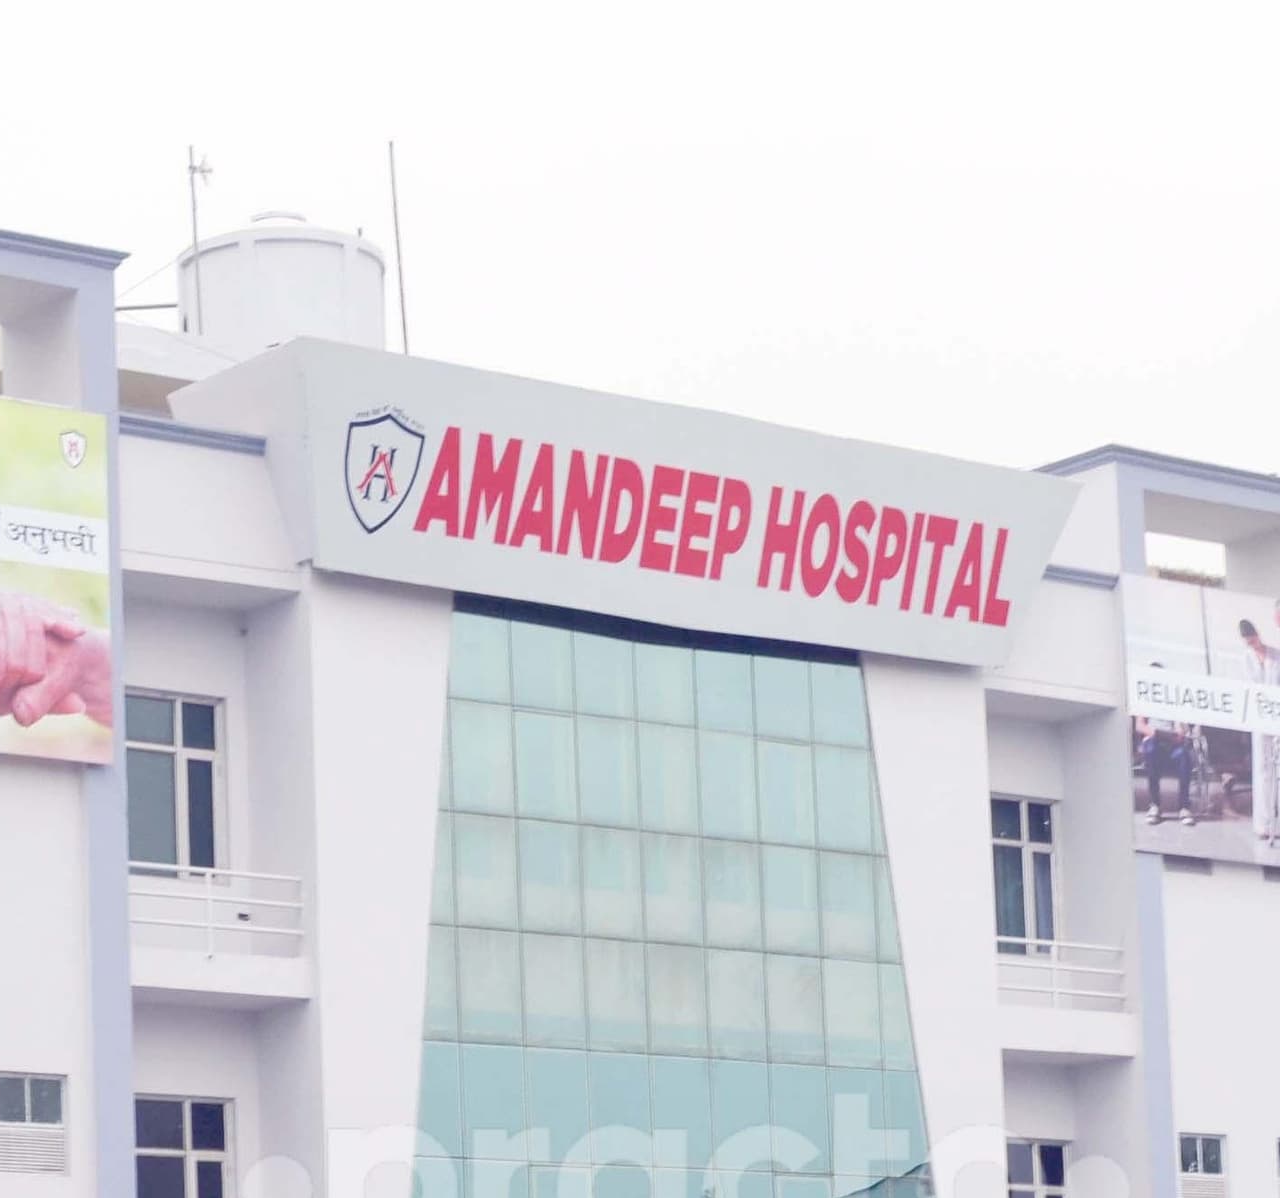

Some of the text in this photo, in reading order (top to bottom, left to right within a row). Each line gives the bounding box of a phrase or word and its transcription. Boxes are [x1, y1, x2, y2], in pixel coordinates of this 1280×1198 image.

[413, 426, 1012, 629] AMANDEEP HOSPITAL
[1136, 679, 1235, 715] RELIABLE
